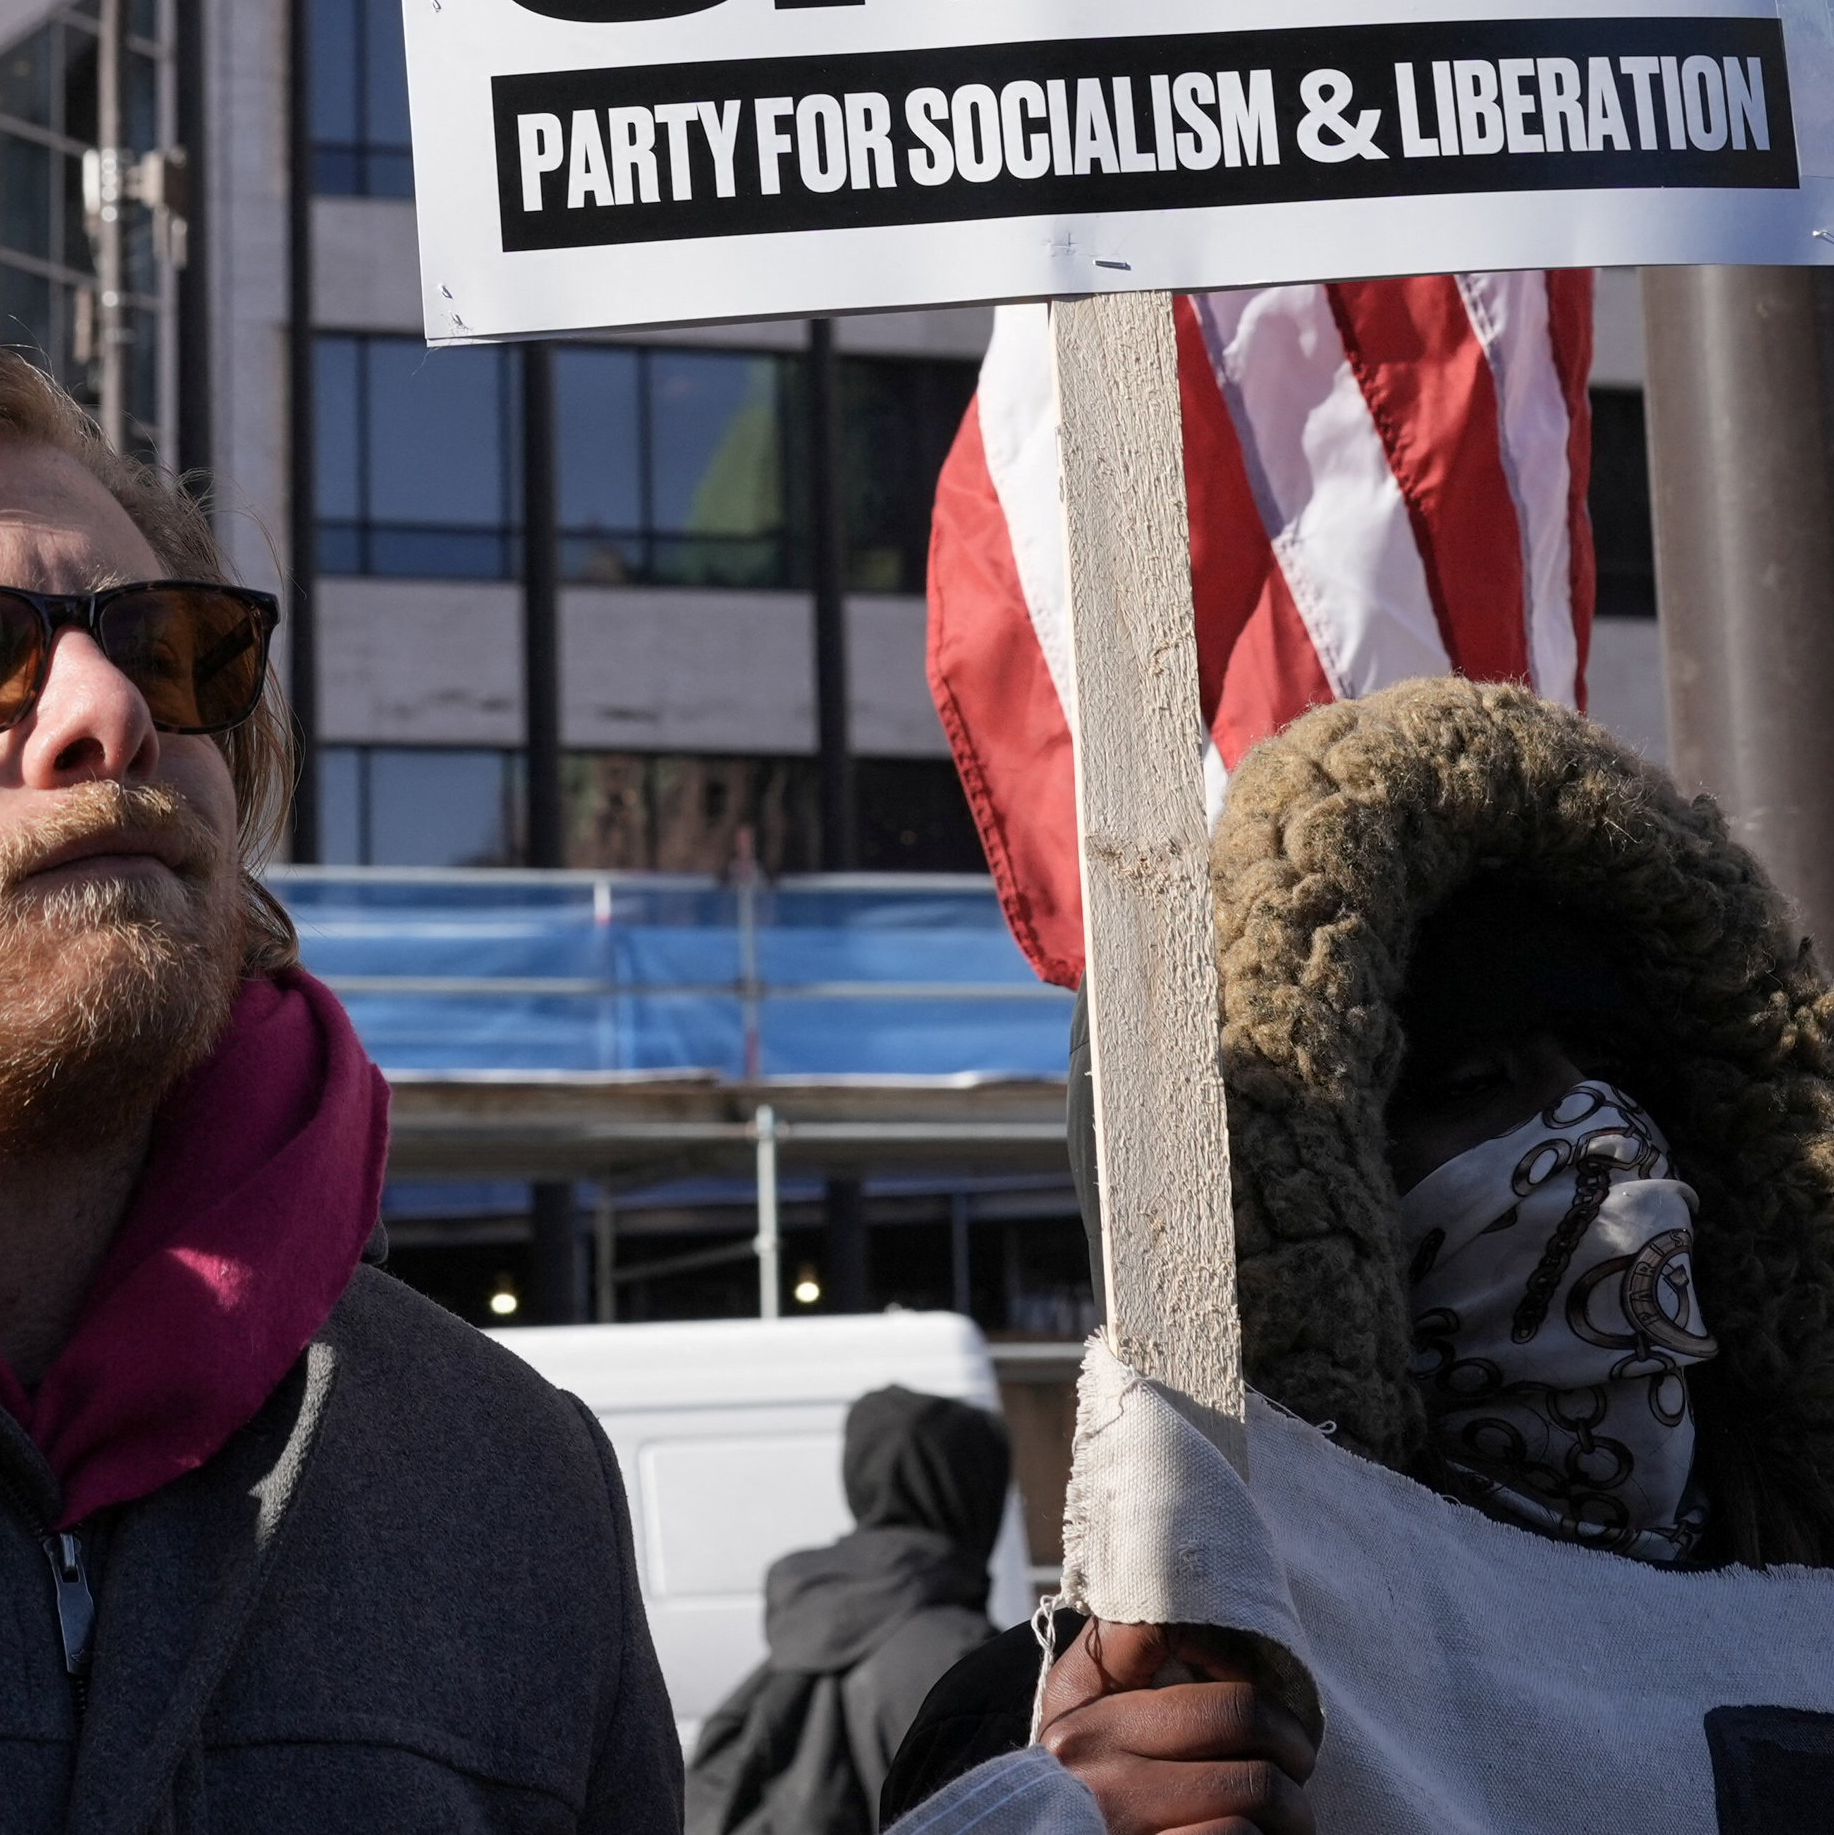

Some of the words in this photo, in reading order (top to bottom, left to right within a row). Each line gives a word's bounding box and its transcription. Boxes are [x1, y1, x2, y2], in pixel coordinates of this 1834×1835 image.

[517, 98, 743, 213] PARTY
[757, 90, 897, 192] FOR
[905, 70, 1280, 185] SOCIALISM
[1297, 68, 1385, 160] &
[1397, 55, 1771, 160] LIBERATION
[1629, 1229, 1686, 1328] PARIS
